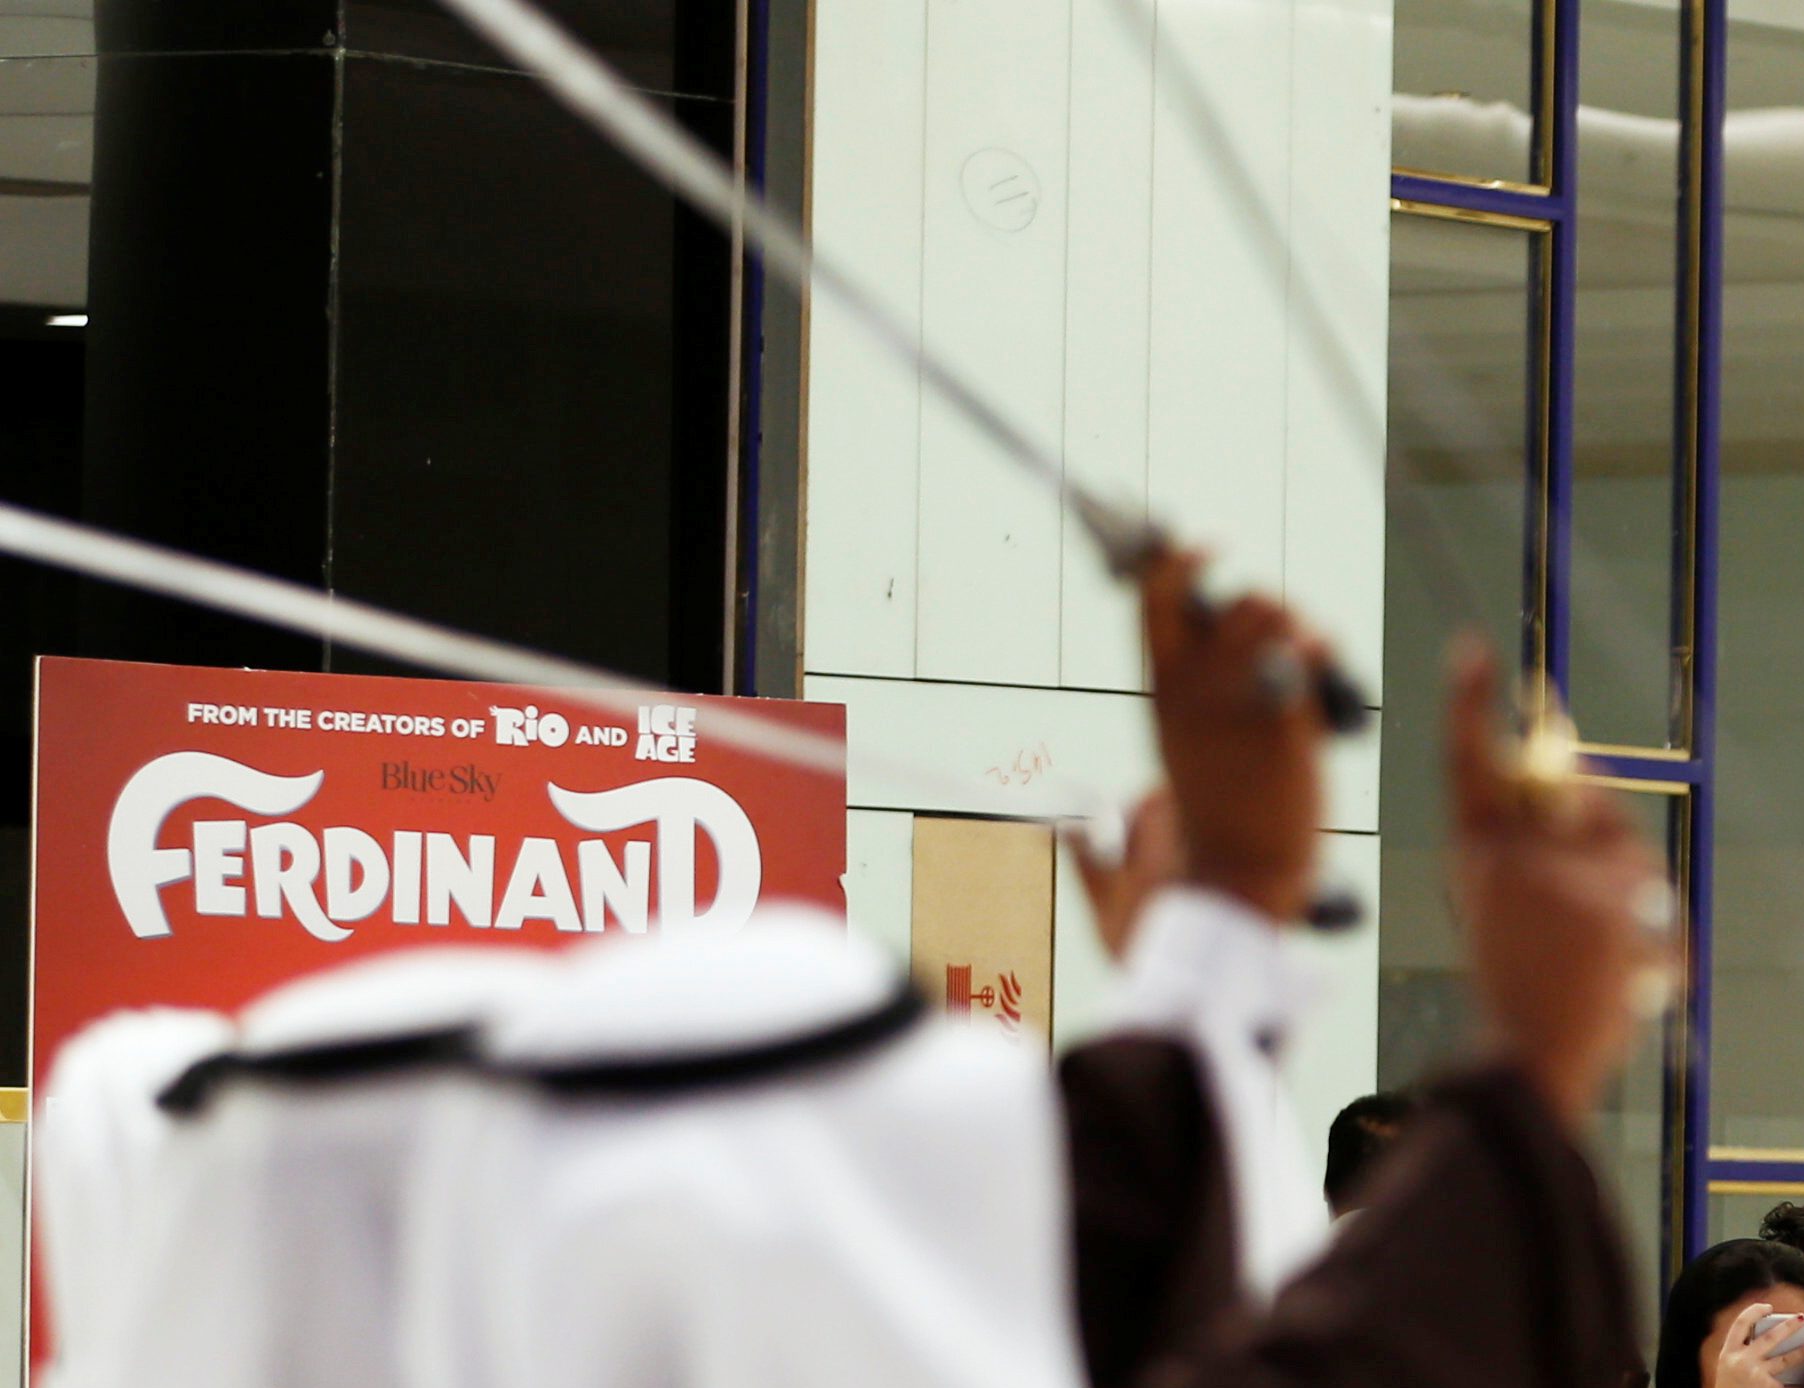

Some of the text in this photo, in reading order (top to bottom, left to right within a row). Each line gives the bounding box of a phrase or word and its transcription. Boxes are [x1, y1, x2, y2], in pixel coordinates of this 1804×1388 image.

[187, 702, 258, 727] FROM
[263, 707, 312, 730] THE
[317, 711, 446, 738] CREATORS
[450, 718, 486, 739] OF
[574, 726, 629, 747] AND
[637, 704, 698, 737] ICE
[634, 734, 697, 763] AGE
[381, 760, 503, 803] Blue Sky
[106, 750, 763, 942] FERDINAND
